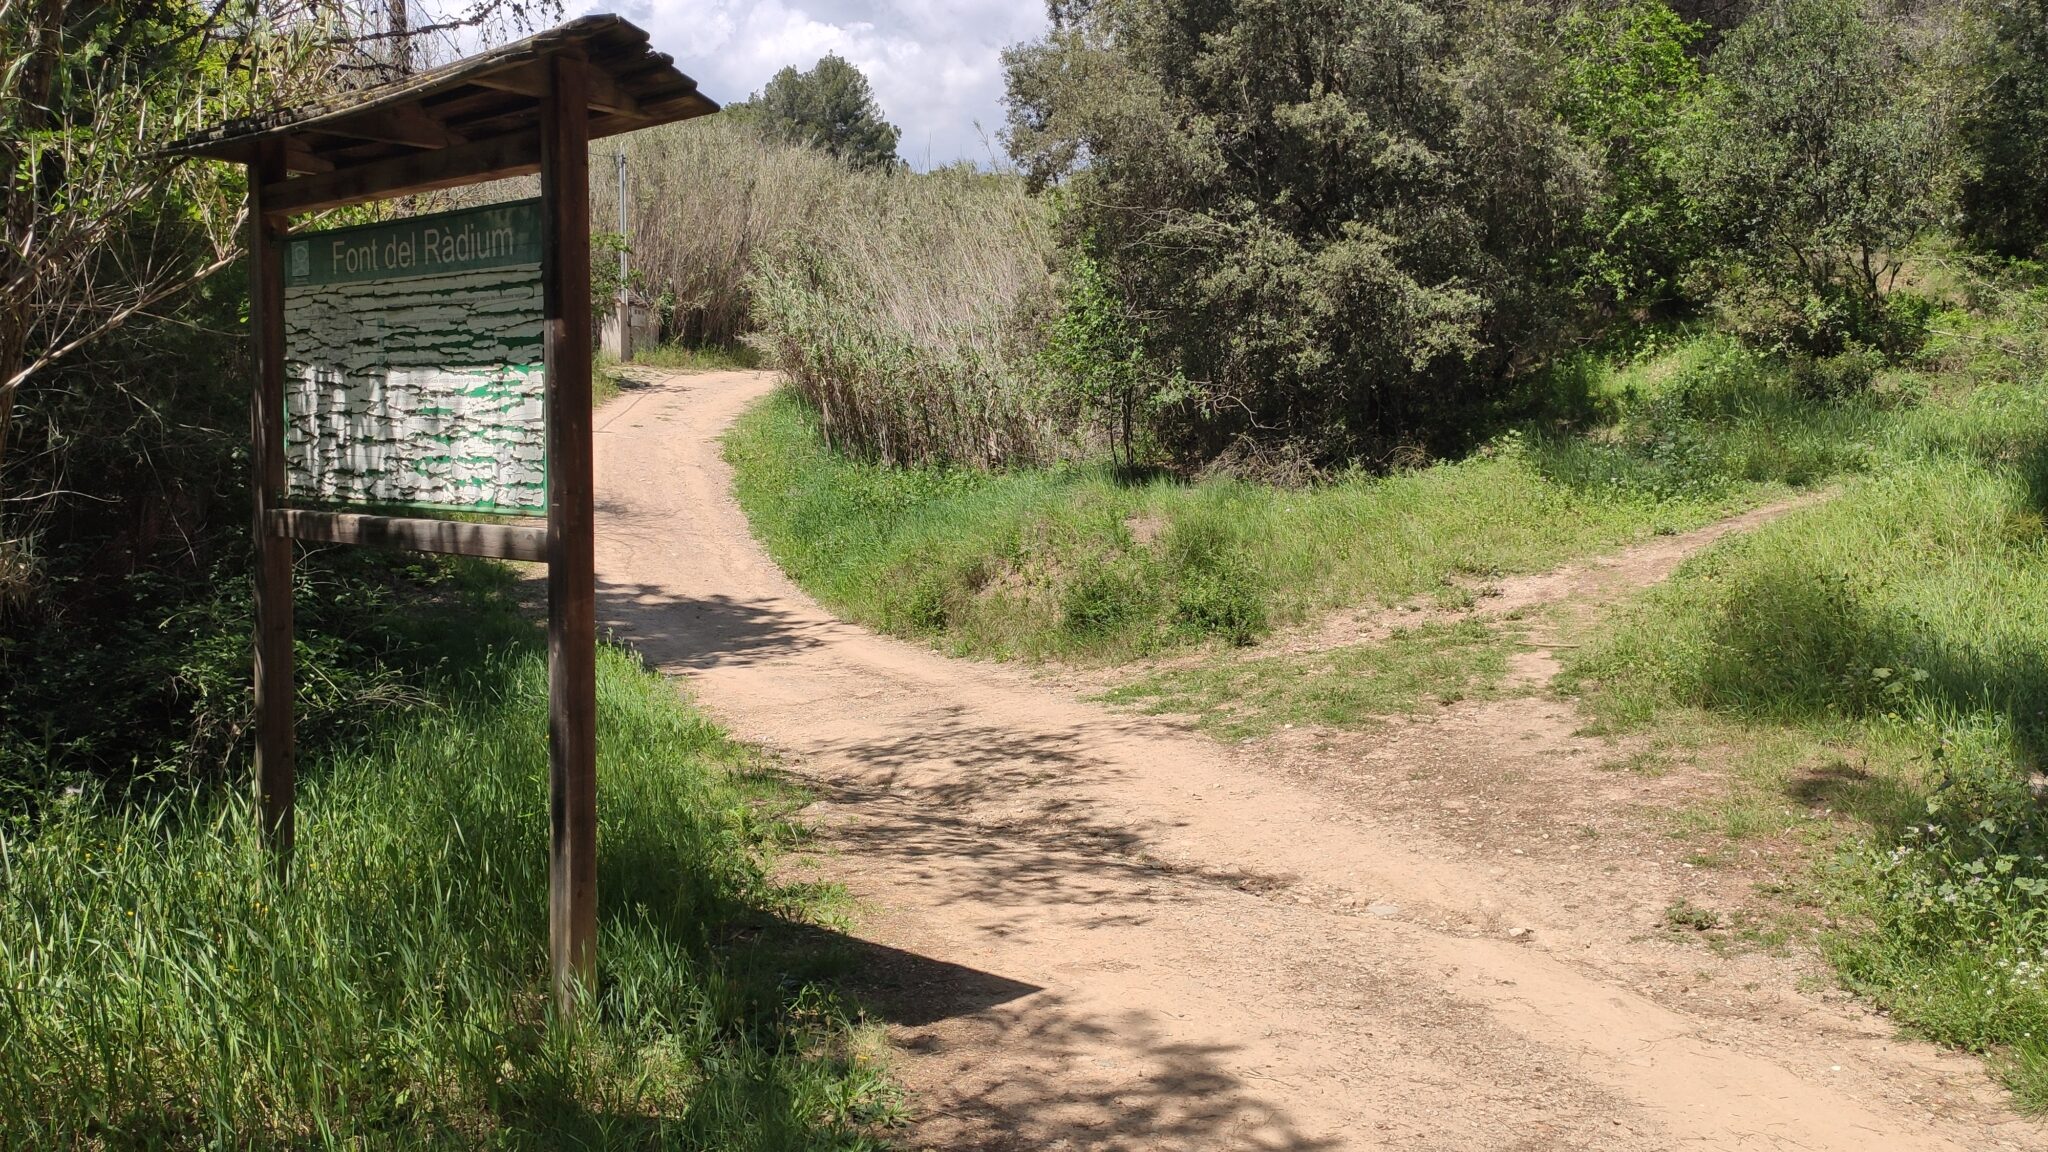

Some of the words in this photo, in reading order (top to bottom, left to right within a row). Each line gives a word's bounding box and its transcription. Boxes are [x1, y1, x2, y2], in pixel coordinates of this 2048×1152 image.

[332, 239, 378, 275] Font
[385, 232, 416, 270] del
[424, 224, 514, 265] Ràdium
